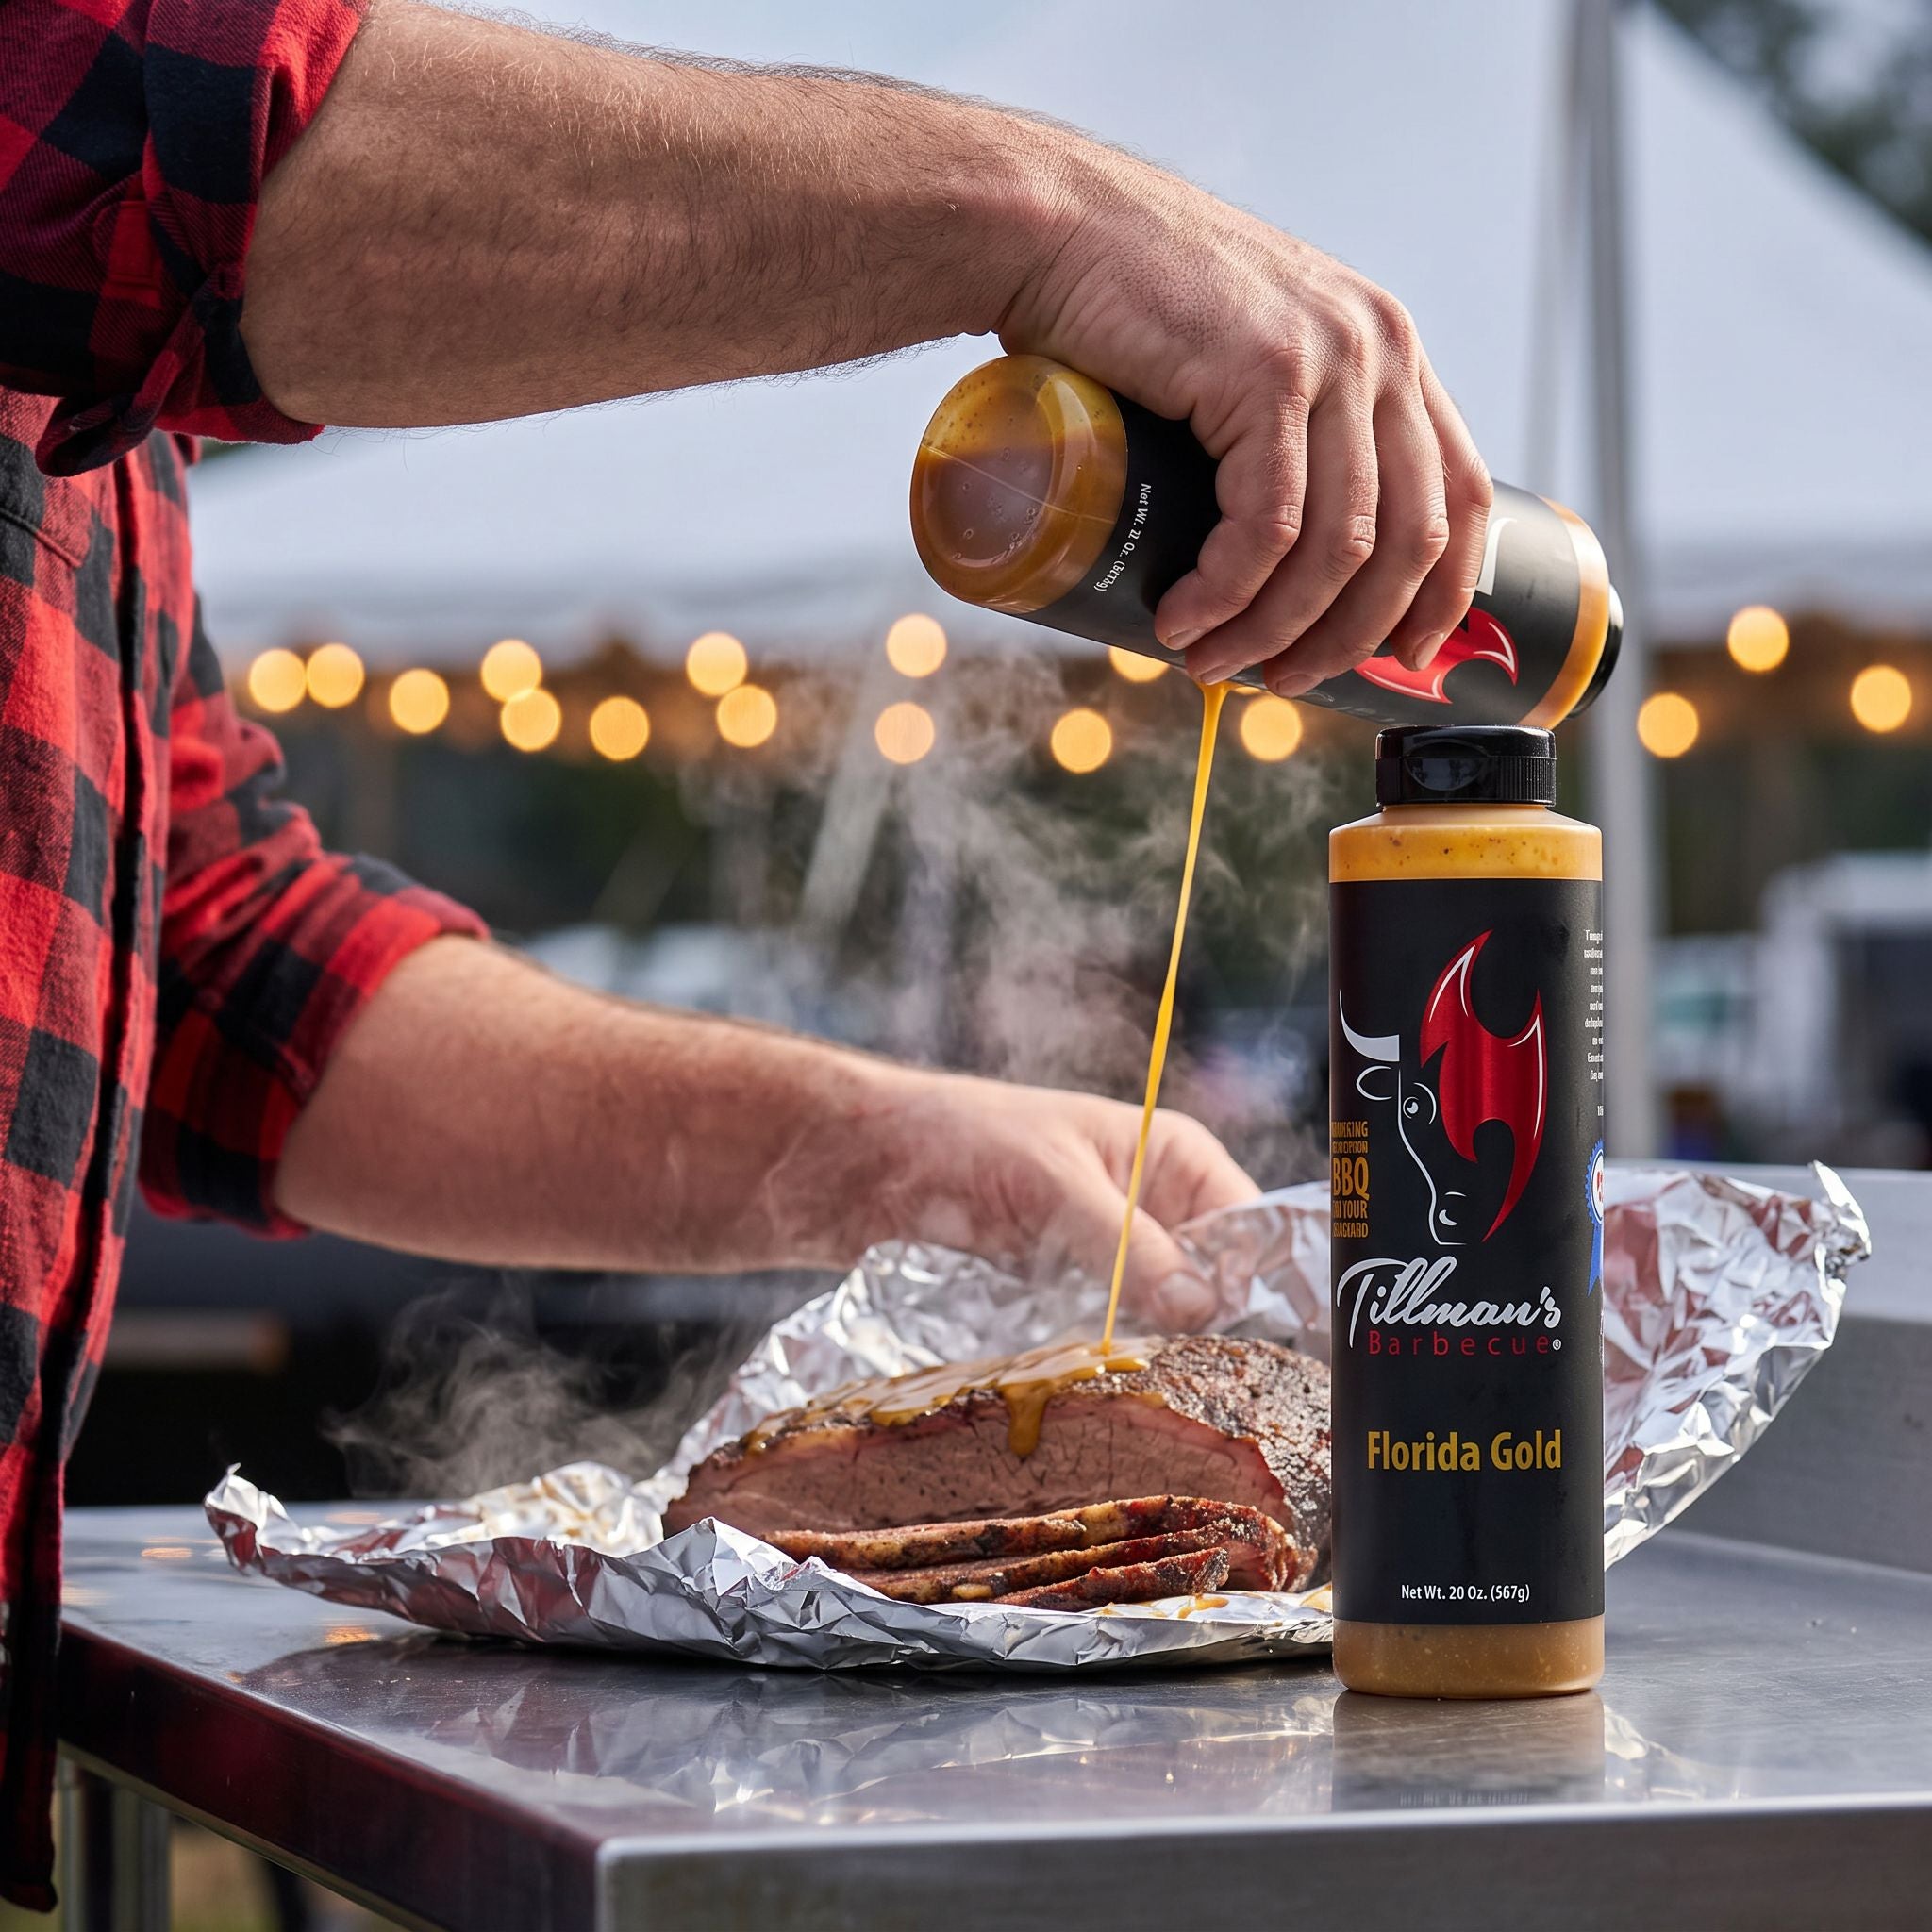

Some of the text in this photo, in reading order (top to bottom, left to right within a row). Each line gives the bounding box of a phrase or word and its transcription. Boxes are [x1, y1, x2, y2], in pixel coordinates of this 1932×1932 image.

[1333, 1157, 1370, 1201] BBQ
[1342, 1199, 1368, 1219] YOUR
[1336, 1256, 1562, 1349] Tillman's
[1368, 1428, 1562, 1472] Florida Gold
[1401, 1583, 1531, 1603] Net Wt. 20 Oz. (567g)
